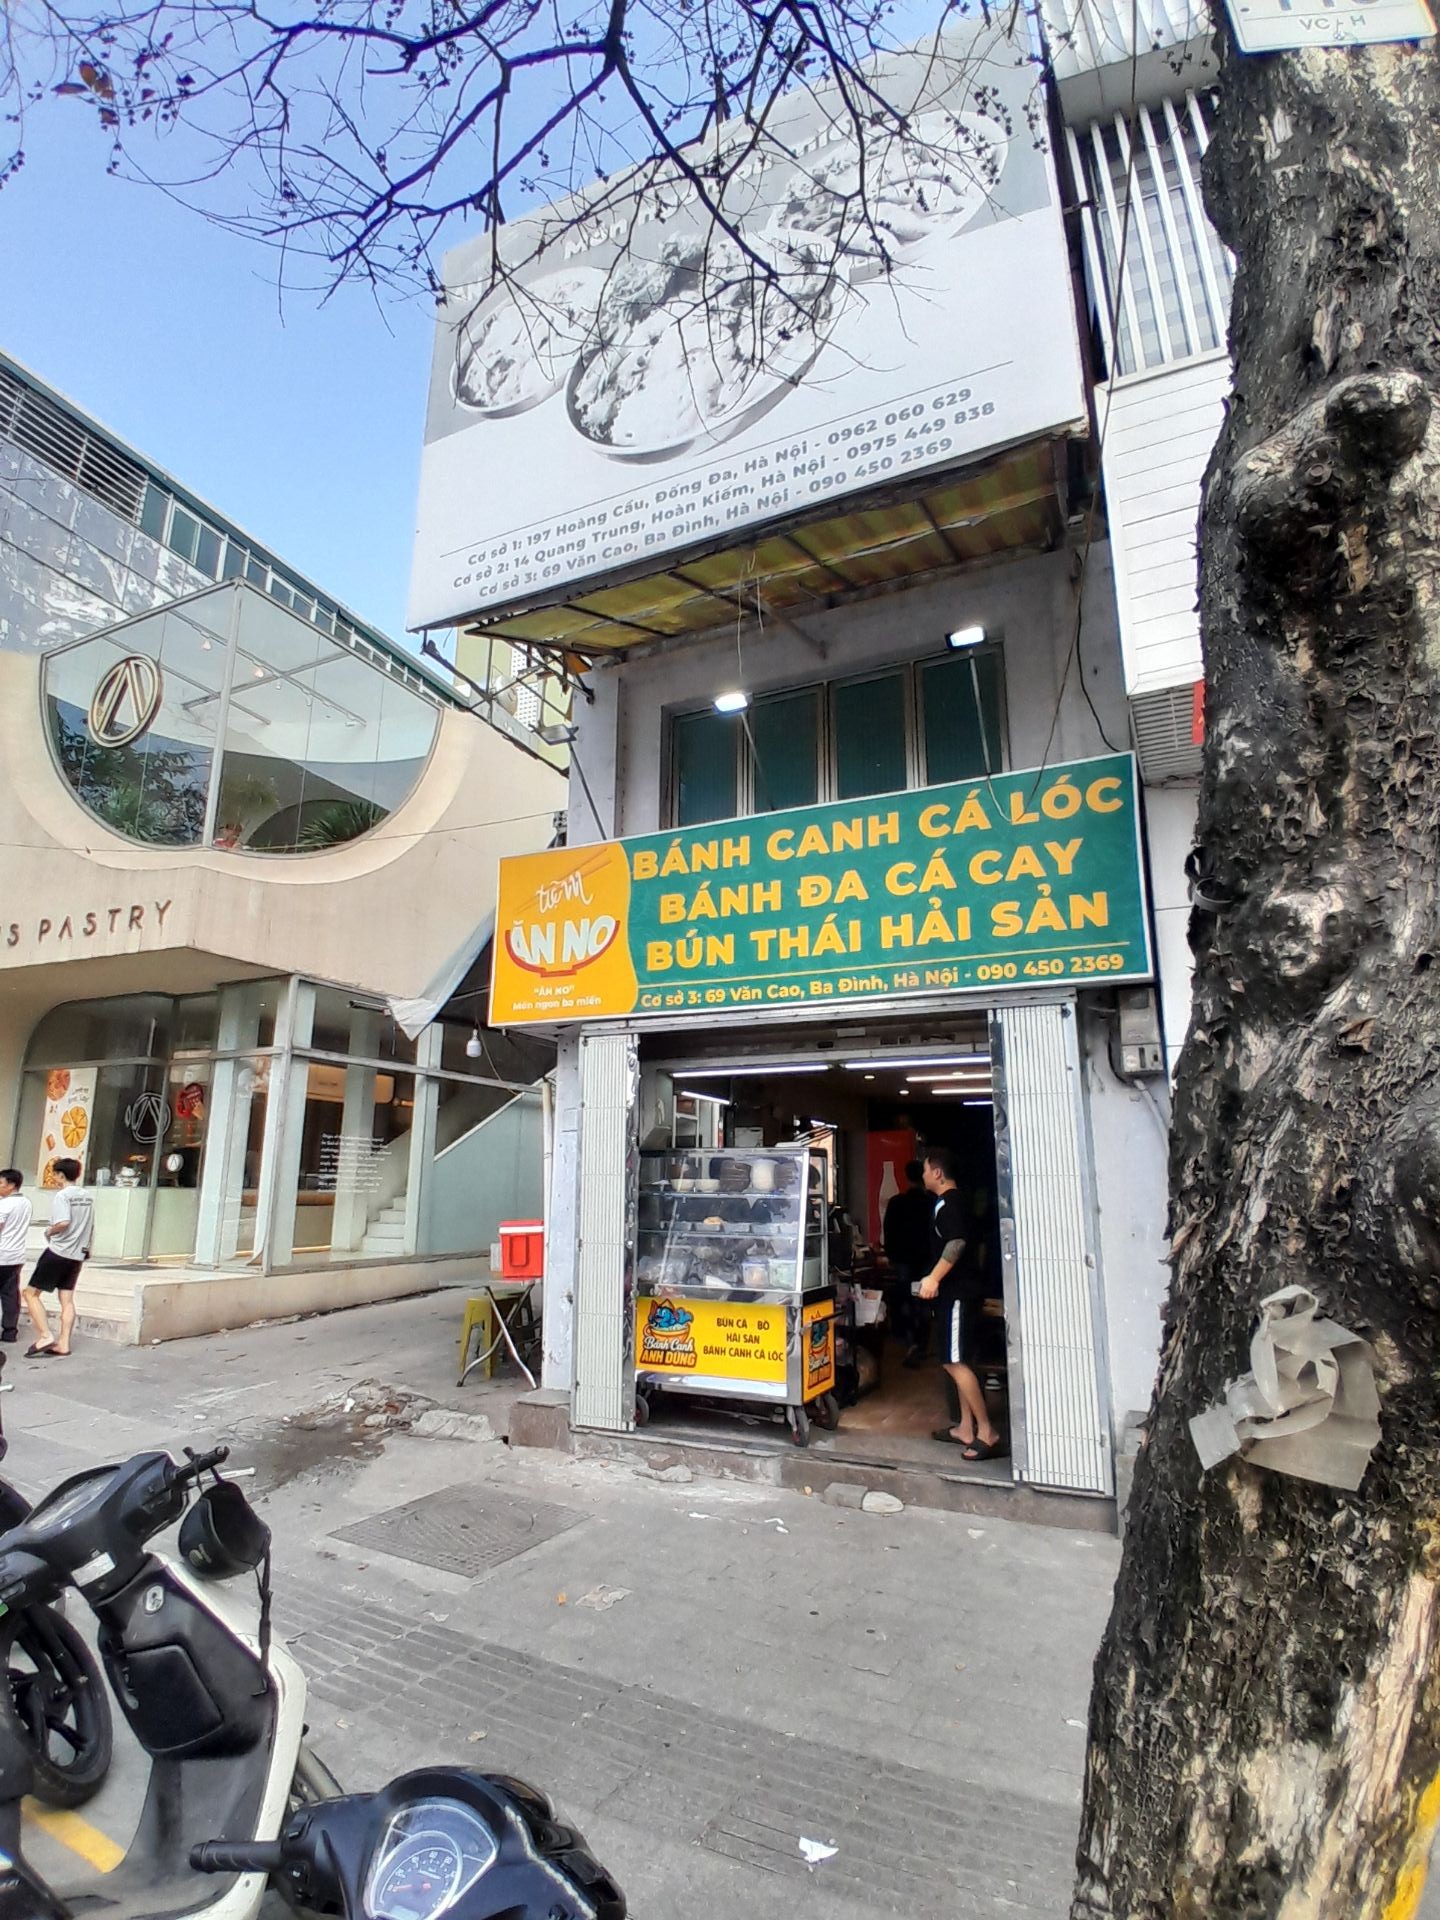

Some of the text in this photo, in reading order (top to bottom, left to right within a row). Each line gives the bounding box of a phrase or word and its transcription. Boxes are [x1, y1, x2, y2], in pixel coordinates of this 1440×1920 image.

[453, 576, 471, 588] Cơ
[497, 563, 509, 574] 2:
[514, 555, 530, 568] 14
[534, 538, 586, 562] Quang
[591, 520, 645, 543] Trung,
[652, 502, 696, 524] Hoàn
[761, 470, 786, 488] Hà
[793, 455, 825, 478] Nội
[847, 433, 897, 460] 0975
[904, 418, 946, 440] 449
[954, 402, 995, 425] 838
[468, 554, 486, 566] Cơ
[512, 540, 522, 551] 1:
[527, 529, 551, 547] 197
[556, 513, 607, 537] Hoàng
[655, 480, 702, 504] Đống
[708, 470, 738, 485] Đa,
[744, 456, 768, 473] Hà
[775, 440, 807, 463] Nội
[828, 419, 878, 445] 0962
[885, 404, 924, 426] 060
[932, 388, 972, 410] 629
[479, 585, 498, 598] Cơ
[524, 572, 538, 584] 3:
[542, 563, 561, 578] 69
[566, 553, 597, 571] Văn
[602, 542, 639, 560] Cao,
[644, 531, 666, 546] Ba
[672, 514, 720, 538] Đình,
[726, 502, 750, 520] Hà
[757, 488, 789, 510] Nội
[809, 472, 847, 492] 090
[854, 457, 893, 478] 450
[900, 437, 953, 465] 2369
[632, 773, 1124, 881] BÁNH CANH CÁ LÓC
[38, 899, 172, 943] PASTRY
[659, 837, 1084, 925] BÁNH ĐA CÁ CAY
[510, 914, 616, 965] ĂN NO
[646, 883, 1109, 972] BÚN THÁI HẢI SẢN
[640, 993, 662, 1007] Cơ
[666, 990, 684, 1006] sở
[687, 991, 701, 1005] 3:
[705, 988, 726, 1003] 69
[730, 985, 762, 1001] Văn
[766, 984, 805, 999] Cao,
[809, 980, 833, 995] Ba
[838, 975, 889, 993] Đình,
[893, 971, 919, 988] Hà
[925, 967, 959, 988] Nội
[976, 962, 1018, 981] 090
[1023, 959, 1065, 976] 450
[1070, 953, 1125, 974] 2369
[642, 1350, 664, 1363] ANH
[728, 1347, 752, 1358] CANH
